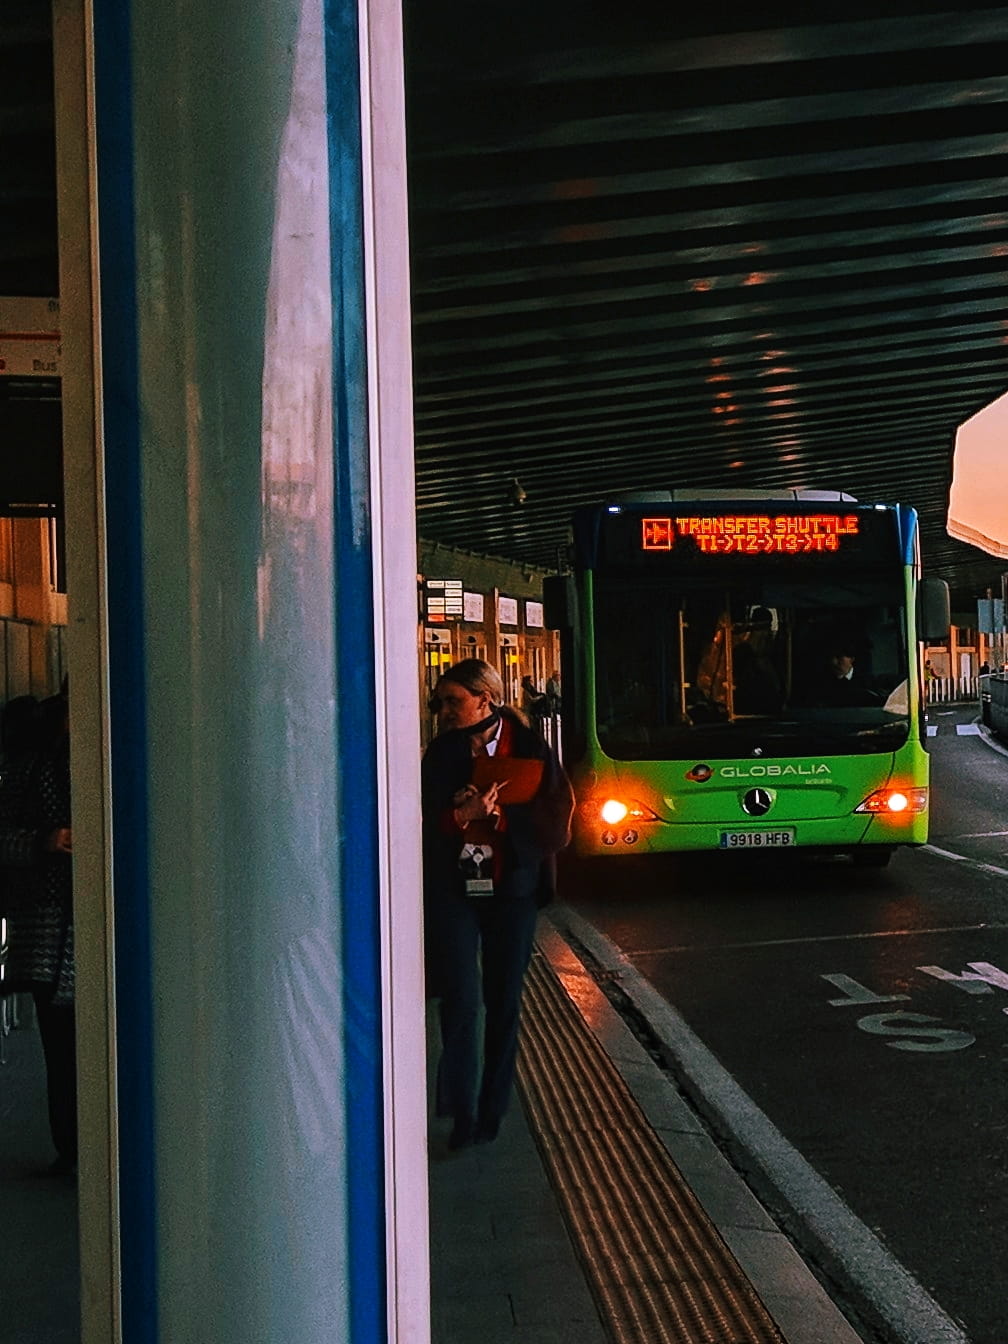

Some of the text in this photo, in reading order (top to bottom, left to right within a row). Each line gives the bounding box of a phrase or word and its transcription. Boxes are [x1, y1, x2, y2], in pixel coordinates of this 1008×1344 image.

[676, 516, 858, 534] TRANSFER SHUTTLE
[720, 763, 832, 778] GLOBALIA
[729, 832, 791, 846] 9918 HFB
